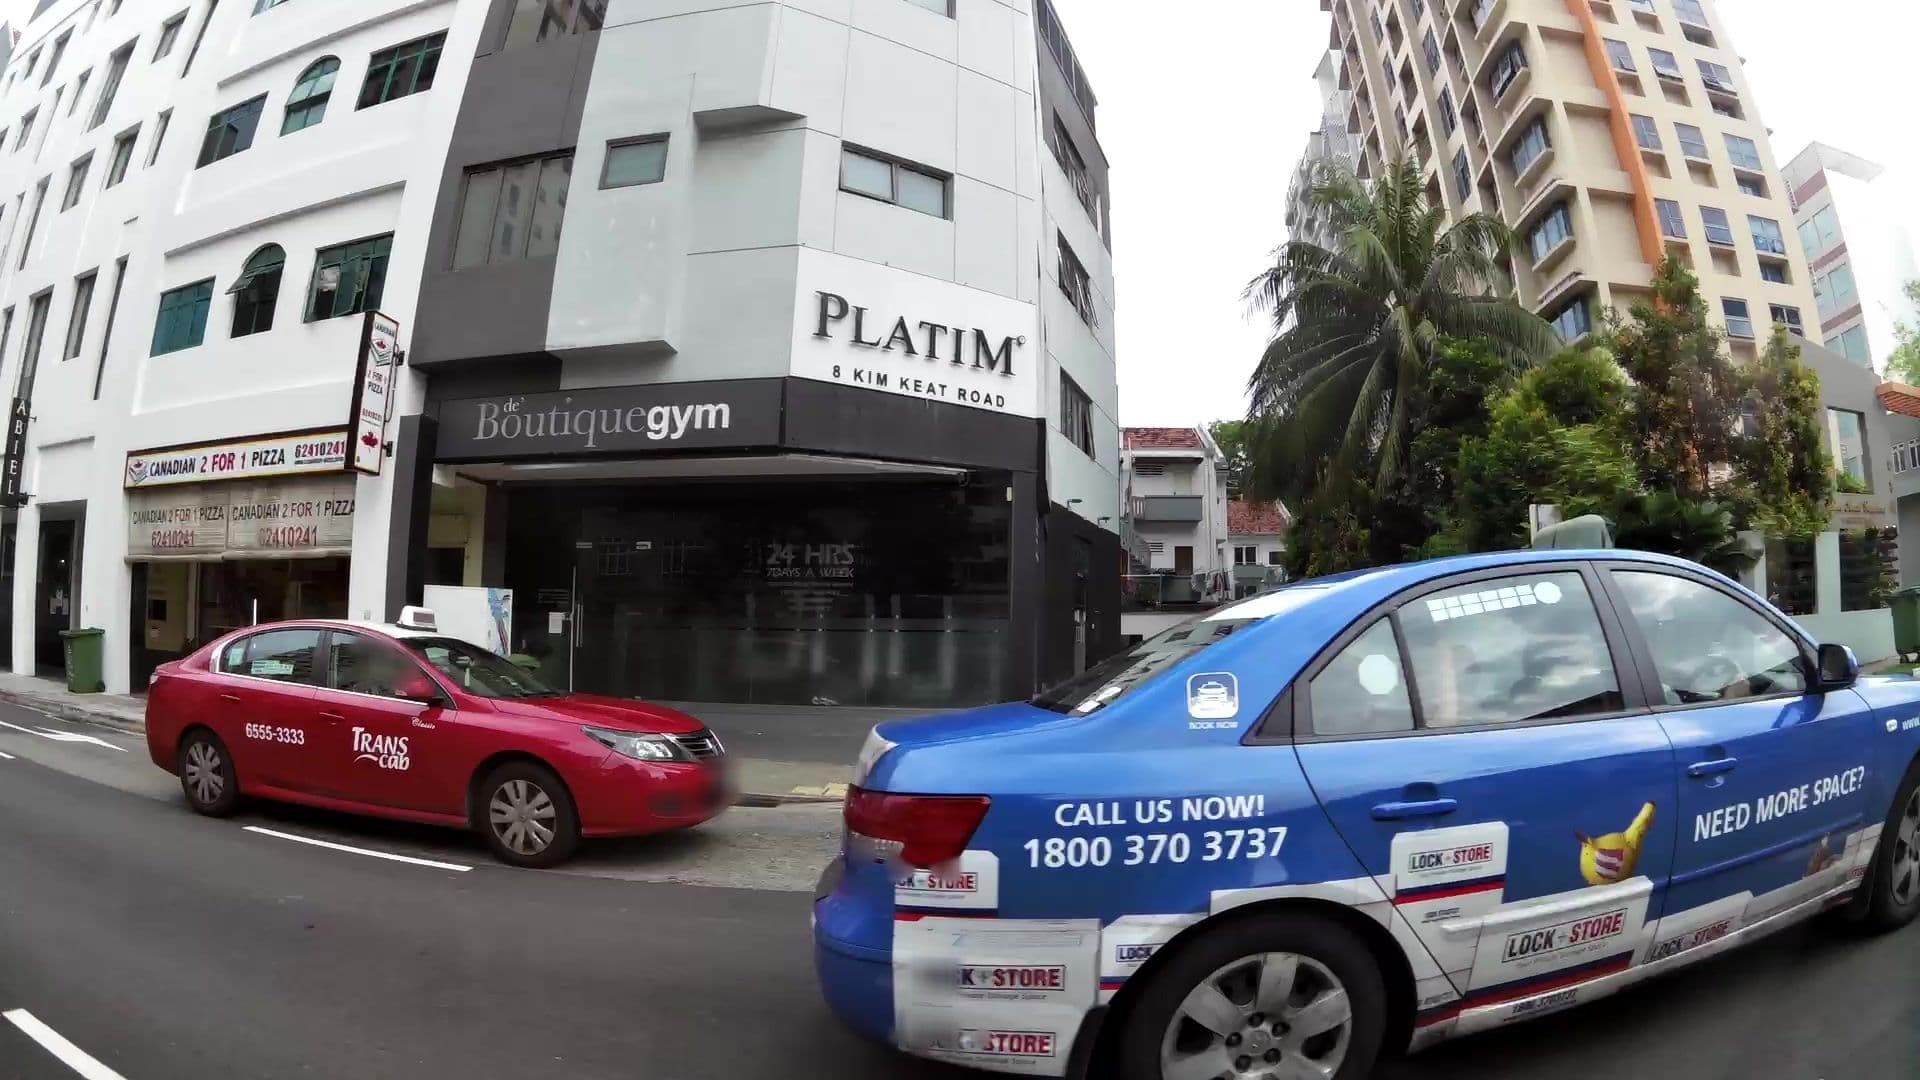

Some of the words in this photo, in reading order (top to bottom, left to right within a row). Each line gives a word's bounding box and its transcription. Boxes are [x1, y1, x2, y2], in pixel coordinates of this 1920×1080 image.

[367, 381, 383, 395] PIZZA
[832, 364, 841, 378] 8
[853, 368, 888, 387] KIM
[900, 377, 948, 397] KEAT
[957, 388, 1005, 407] ROAD
[8, 400, 26, 495] ABIEL
[150, 457, 196, 477] CANADIAN
[200, 458, 208, 473] 2
[212, 453, 235, 472] FOR
[241, 452, 246, 469] 1
[251, 448, 285, 467] PIZZA
[295, 440, 345, 459] 62410241
[132, 508, 167, 525] CANADIAN
[168, 508, 174, 522] 2
[175, 507, 191, 523] FOR
[193, 508, 198, 522] 1
[200, 506, 224, 521] PIZZA
[232, 503, 279, 521] CANADIAN
[282, 503, 289, 518] 2
[291, 502, 313, 517] FOR
[316, 502, 321, 516] 1
[324, 500, 355, 516] PIZZA
[767, 543, 796, 565] 24
[804, 543, 855, 565] HRS
[805, 567, 814, 577] A
[820, 567, 855, 578] WEEK
[245, 723, 305, 745] 6555-3333
[352, 726, 409, 756] TRANS
[378, 752, 410, 771] cab
[1054, 802, 1127, 826] CALL
[1135, 799, 1173, 824] US
[1182, 794, 1265, 821] NOW!
[1694, 803, 1750, 842] NEED
[1755, 784, 1809, 825] MORE
[1812, 765, 1866, 806] SPACE?
[1023, 836, 1112, 868] 1800
[1124, 832, 1191, 866] 370
[1201, 826, 1289, 861] 3737
[1411, 853, 1444, 870] LOCK
[1452, 846, 1491, 864] STORE
[1507, 928, 1556, 958] LOCK
[1568, 912, 1625, 944] STORE
[993, 968, 1061, 988] STORE
